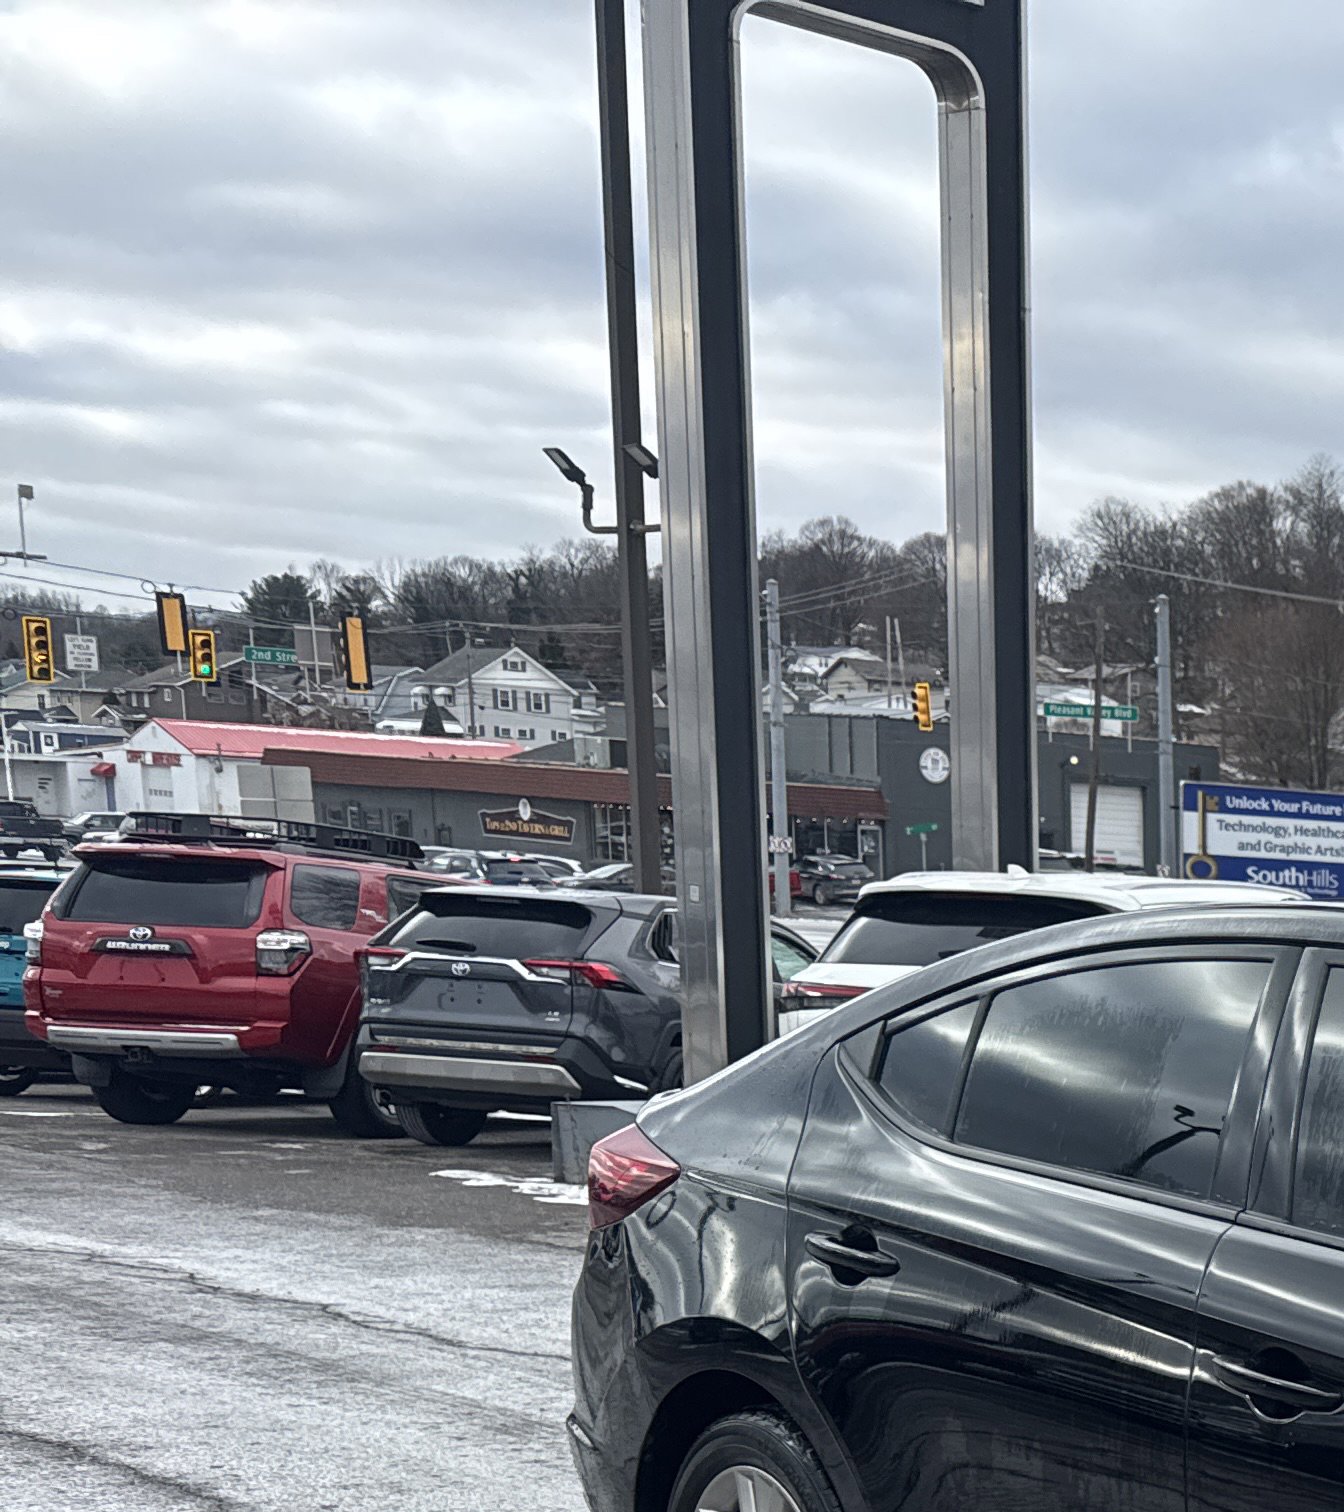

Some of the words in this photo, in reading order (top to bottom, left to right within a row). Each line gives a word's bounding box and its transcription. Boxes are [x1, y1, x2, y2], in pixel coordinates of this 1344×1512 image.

[251, 649, 271, 660] 2nd
[275, 651, 298, 662] Stre
[1049, 703, 1084, 715] Pleasant
[1087, 706, 1112, 718] Vey
[1113, 708, 1132, 718] Blvd
[1225, 795, 1270, 811] Unlock
[1271, 798, 1300, 813] Your
[1301, 801, 1342, 816] Future
[1217, 818, 1291, 839] Technology,
[1237, 840, 1261, 852] and
[1263, 840, 1313, 856] Graphic
[1314, 845, 1344, 858] Arts!
